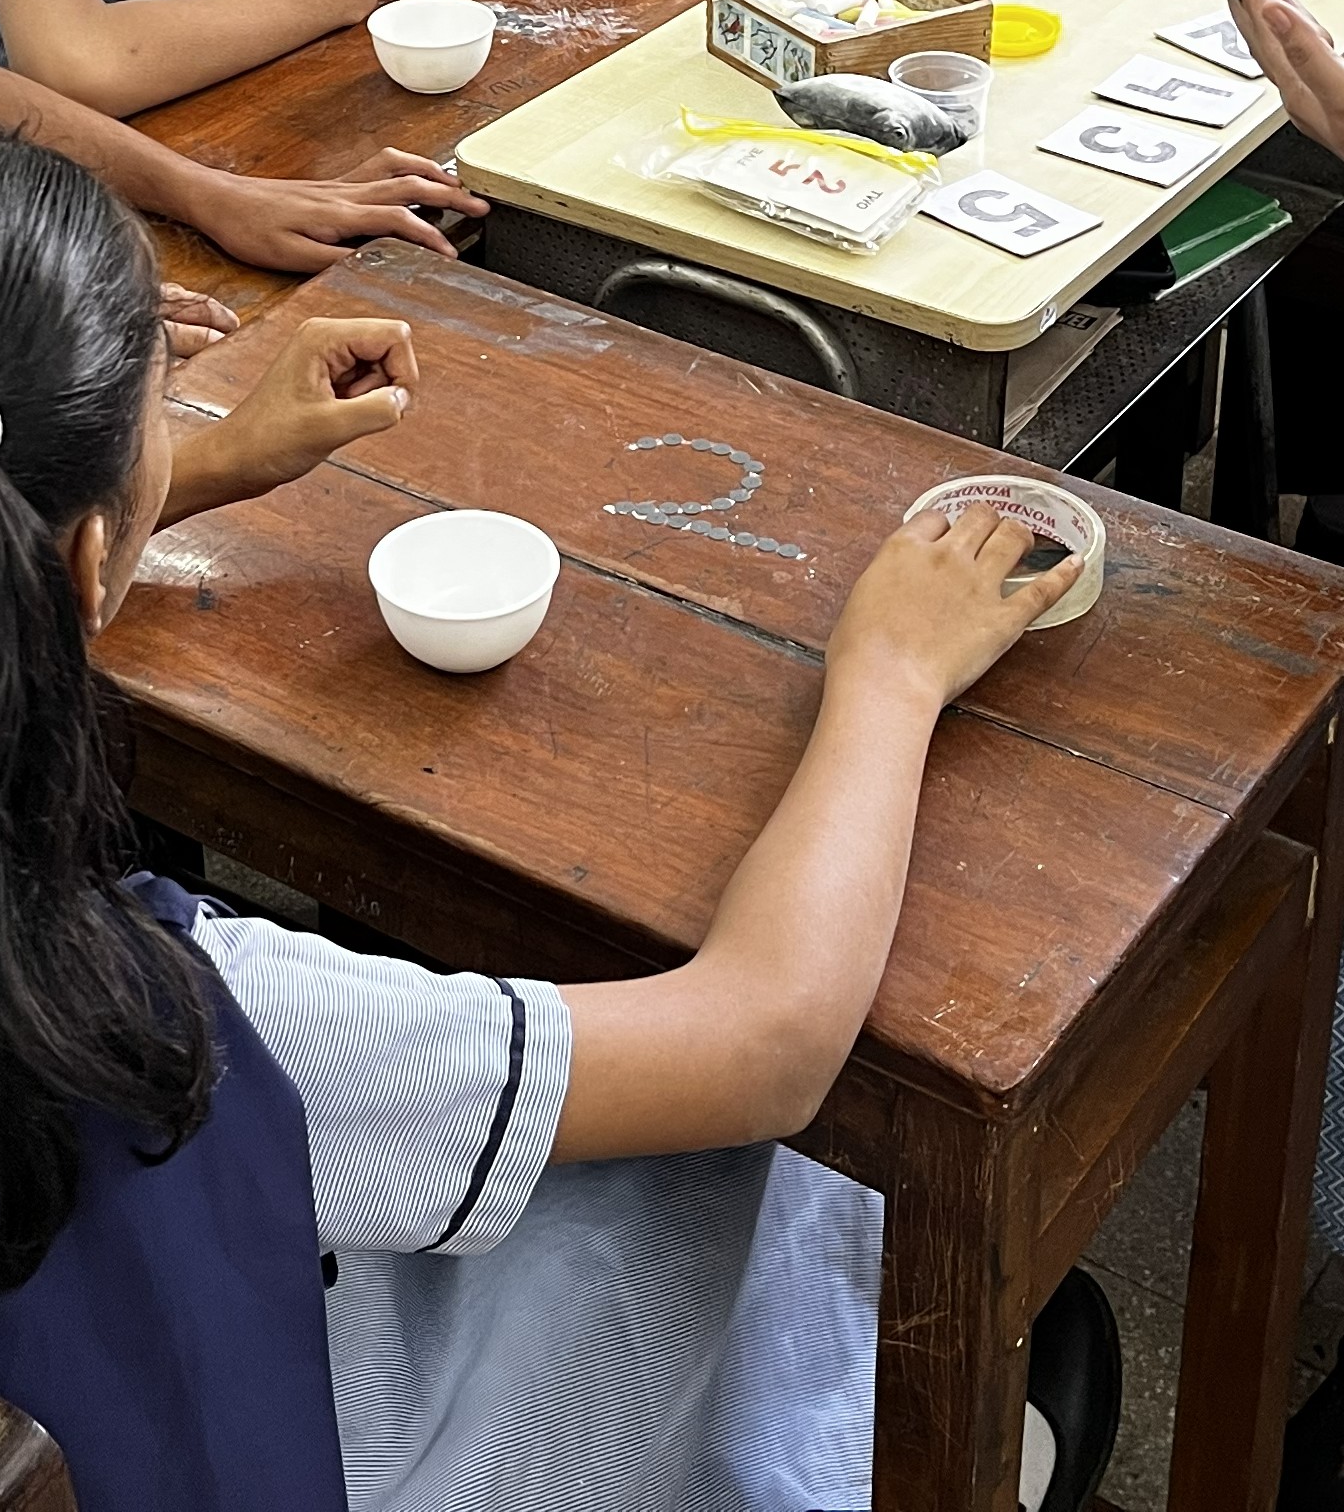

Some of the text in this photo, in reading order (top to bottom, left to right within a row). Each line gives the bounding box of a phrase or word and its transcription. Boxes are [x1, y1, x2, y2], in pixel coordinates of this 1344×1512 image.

[1125, 77, 1234, 101] 4
[1078, 125, 1177, 164] 3
[737, 147, 764, 167] FIVE
[801, 169, 846, 194] 2
[856, 190, 884, 210] TWO
[958, 189, 1060, 238] 5
